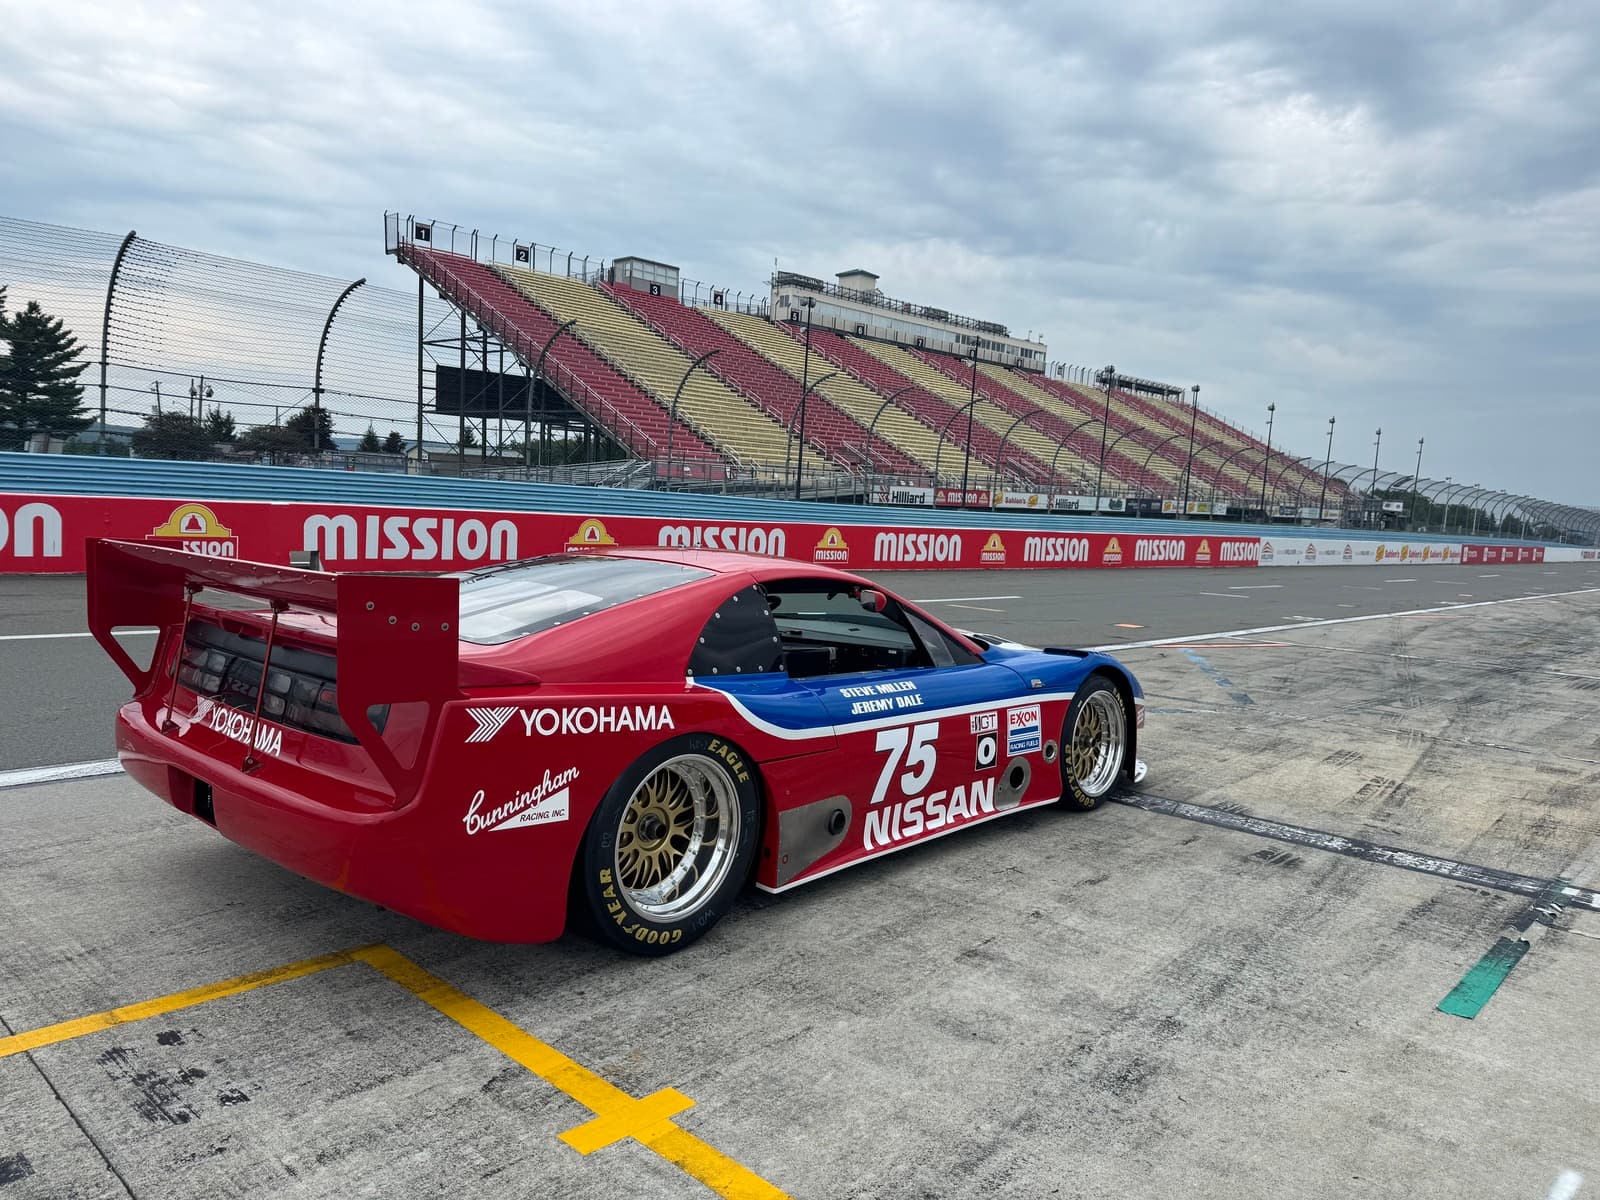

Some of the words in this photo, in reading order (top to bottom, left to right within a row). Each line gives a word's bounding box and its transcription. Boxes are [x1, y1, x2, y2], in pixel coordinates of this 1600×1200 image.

[891, 490, 925, 506] Hilliard
[947, 492, 978, 504] MISION
[303, 514, 519, 561] MISSION
[874, 532, 962, 562] MISSION
[1023, 536, 1089, 562] MISSION
[1134, 539, 1185, 561] MISSION
[1219, 542, 1259, 561] MISSION
[840, 685, 878, 698] STEVE
[875, 681, 917, 694] MILLEN
[851, 698, 894, 715] JEREMY
[896, 694, 924, 708] DALE
[1010, 710, 1038, 727] EXXON
[519, 705, 675, 737] YOKOHAMA
[707, 738, 750, 783] EAGLE
[870, 722, 939, 804] 75
[462, 766, 580, 836] Cunningham
[863, 777, 995, 851] NISSAN
[600, 867, 682, 945] GOODYEAR
